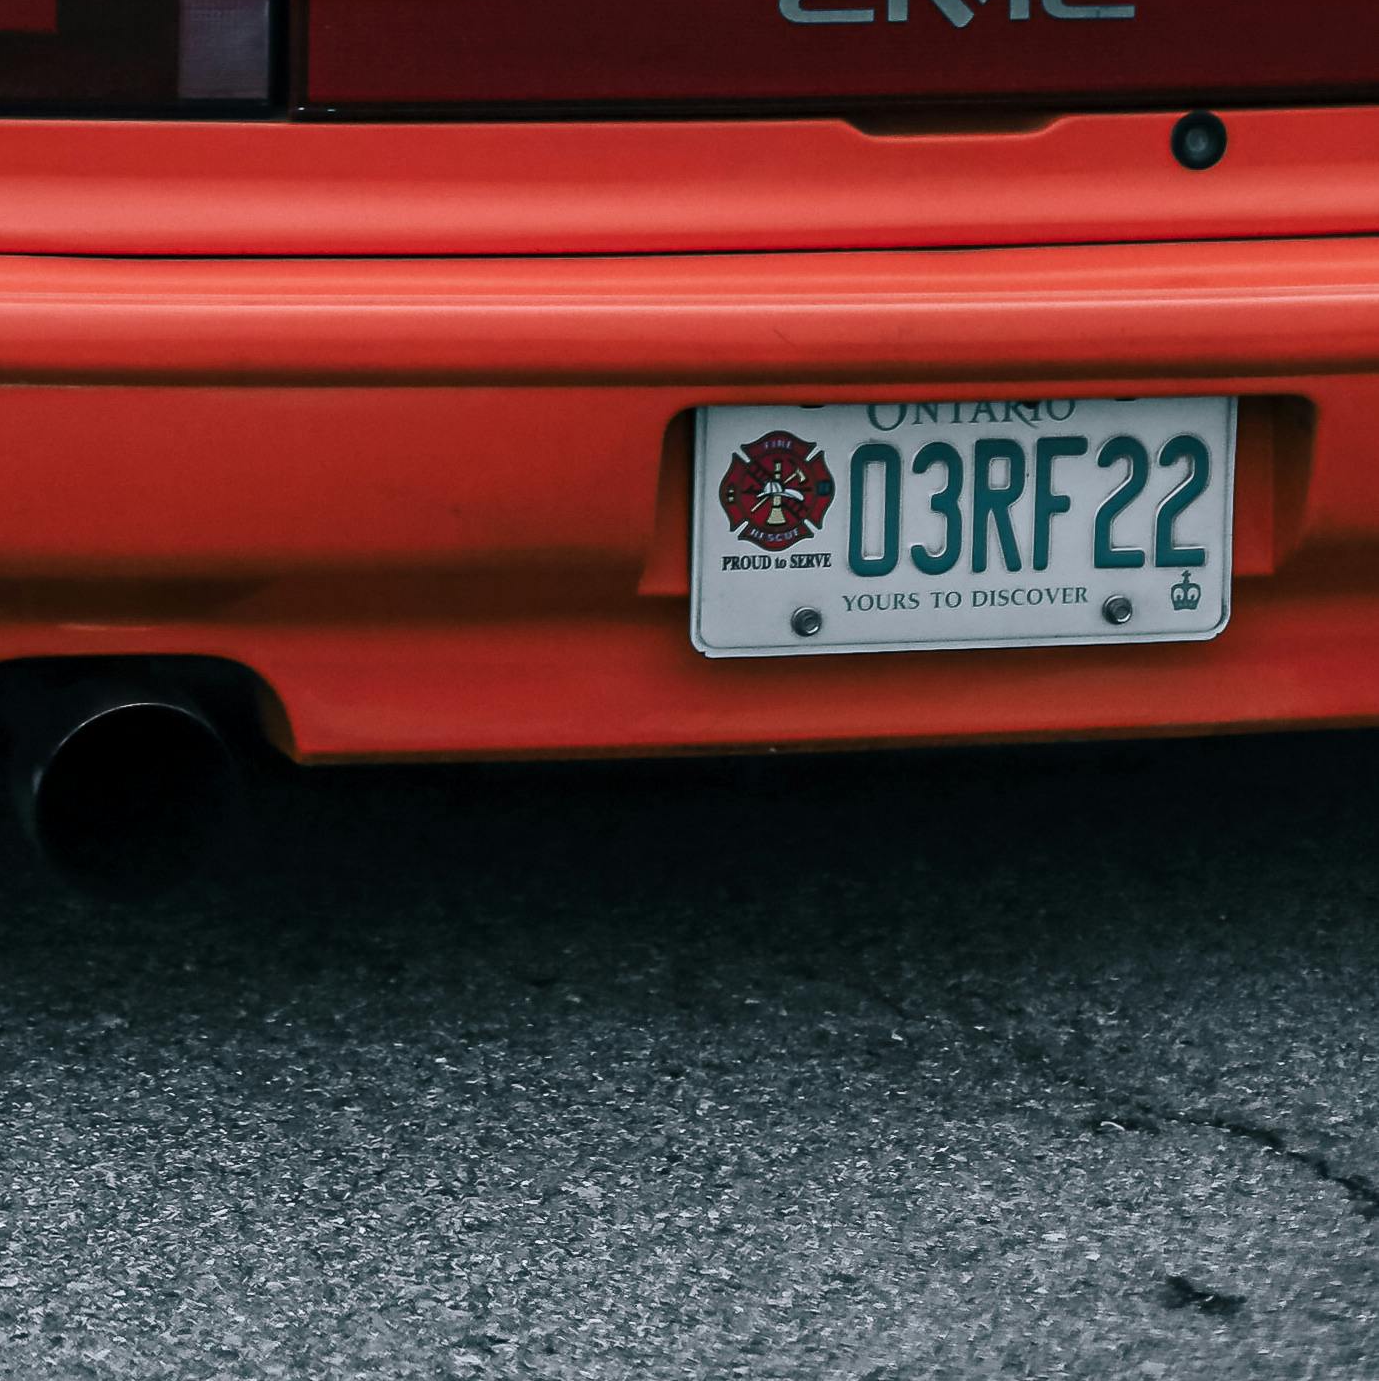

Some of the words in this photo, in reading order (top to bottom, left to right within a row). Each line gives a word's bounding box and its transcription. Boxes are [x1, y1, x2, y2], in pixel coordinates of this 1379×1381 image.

[847, 434, 1212, 577] 03RF22
[722, 555, 772, 571] PROUD
[775, 557, 787, 569] to
[790, 553, 832, 569] SERVE
[841, 591, 920, 612] YOURS
[930, 590, 962, 609] TO
[972, 587, 1089, 608] DISCOVER
